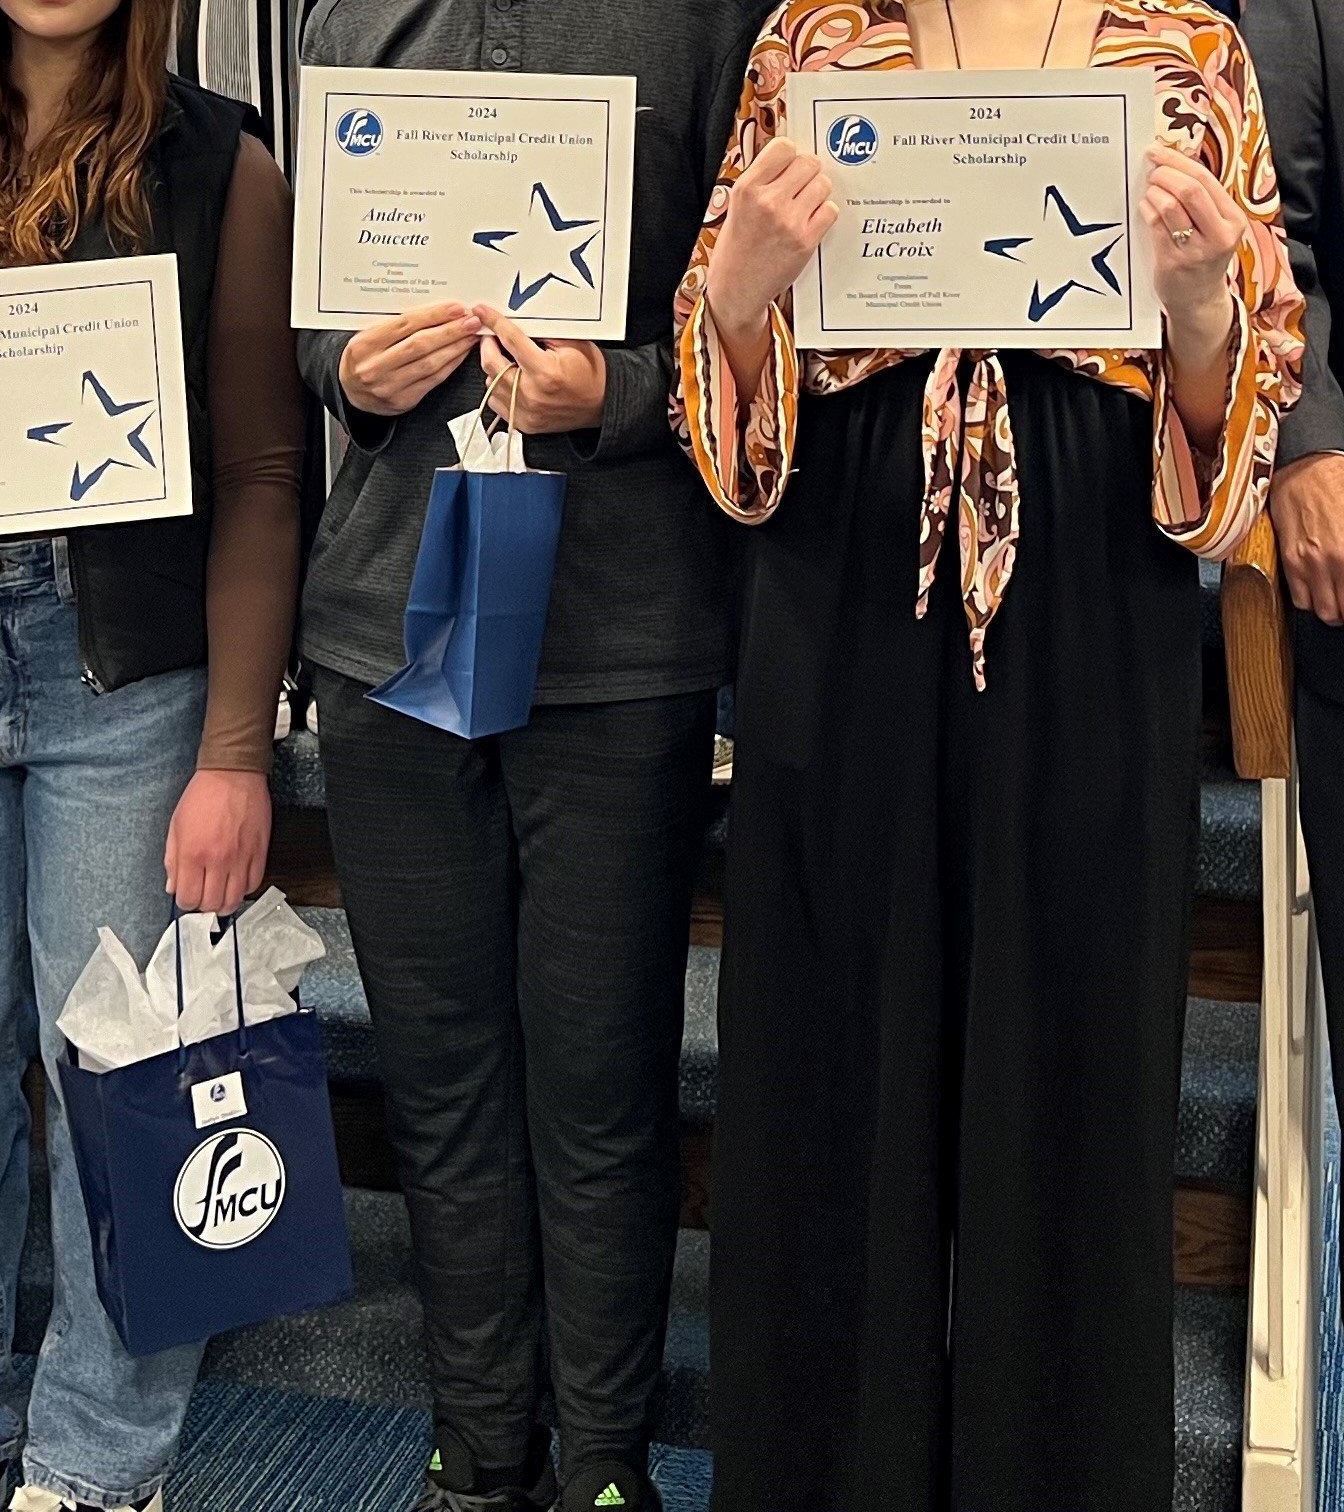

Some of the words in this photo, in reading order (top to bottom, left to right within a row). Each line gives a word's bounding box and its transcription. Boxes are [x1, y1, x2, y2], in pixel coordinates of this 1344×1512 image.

[467, 106, 497, 119] 2024
[969, 107, 1002, 120] 2024
[396, 129, 418, 141] Fall
[422, 130, 454, 142] River
[457, 131, 515, 145] Municipal
[518, 133, 556, 144] Credit
[559, 134, 593, 145] Union
[893, 134, 916, 146] Fall
[921, 133, 954, 146] River
[959, 133, 1023, 148] Municipal
[1026, 133, 1067, 145] Credit
[1071, 132, 1110, 144] Union
[450, 150, 518, 164] Scholarship
[953, 153, 1027, 167] Scholarship
[362, 207, 426, 223] Andrew
[861, 217, 942, 235] Elizabeth
[357, 229, 430, 246] Doucette
[861, 241, 935, 258] LaCroix
[8, 302, 39, 316] 2024
[0, 324, 60, 341] Municipal
[63, 320, 100, 334] Credit
[104, 317, 139, 330] Union
